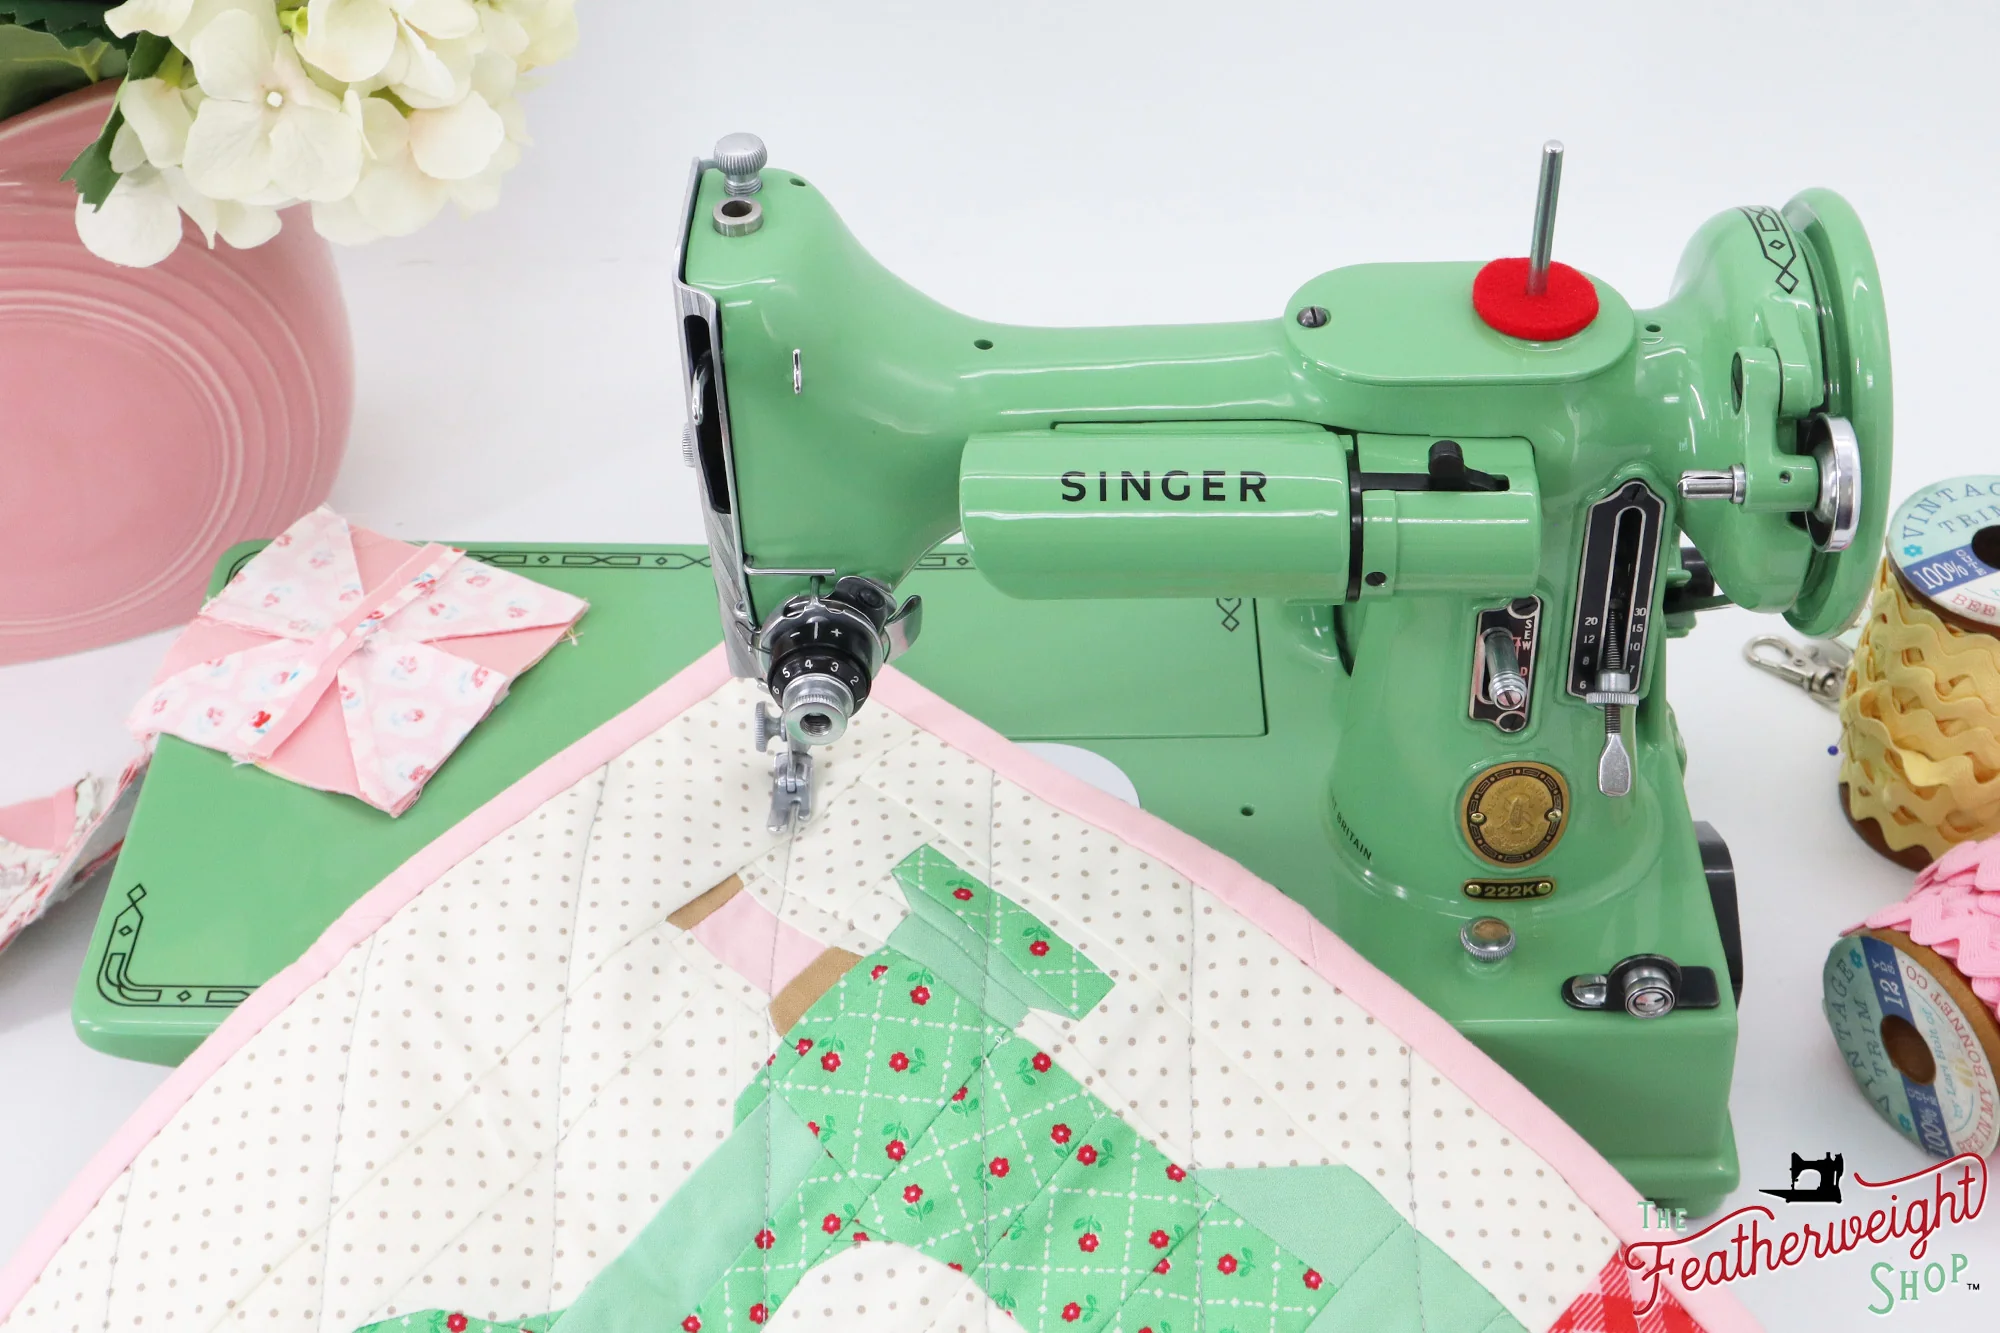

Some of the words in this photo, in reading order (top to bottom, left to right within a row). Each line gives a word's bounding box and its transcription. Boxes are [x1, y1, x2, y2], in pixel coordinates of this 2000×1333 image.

[1061, 470, 1267, 502] SINGER
[1913, 560, 1969, 590] 100%
[1634, 607, 1647, 617] 30
[1952, 593, 1996, 617] BEE
[1584, 616, 1599, 626] 20
[1632, 623, 1644, 633] 15
[1522, 620, 1533, 651] SEW
[1583, 634, 1596, 644] 12
[1629, 642, 1641, 651] 10
[782, 667, 791, 678] 5
[804, 659, 814, 669] 4
[830, 661, 840, 672] 3
[850, 675, 859, 686] 2
[1579, 680, 1587, 689] 6
[1336, 811, 1372, 860] BRITAIN
[1484, 884, 1536, 897] 222K
[1879, 978, 1904, 1009] 12
[1831, 958, 1890, 1114] VINTAGE
[1853, 995, 1888, 1077] TRIM
[1930, 991, 1988, 1080] BONNET
[1978, 1080, 1994, 1118] MY
